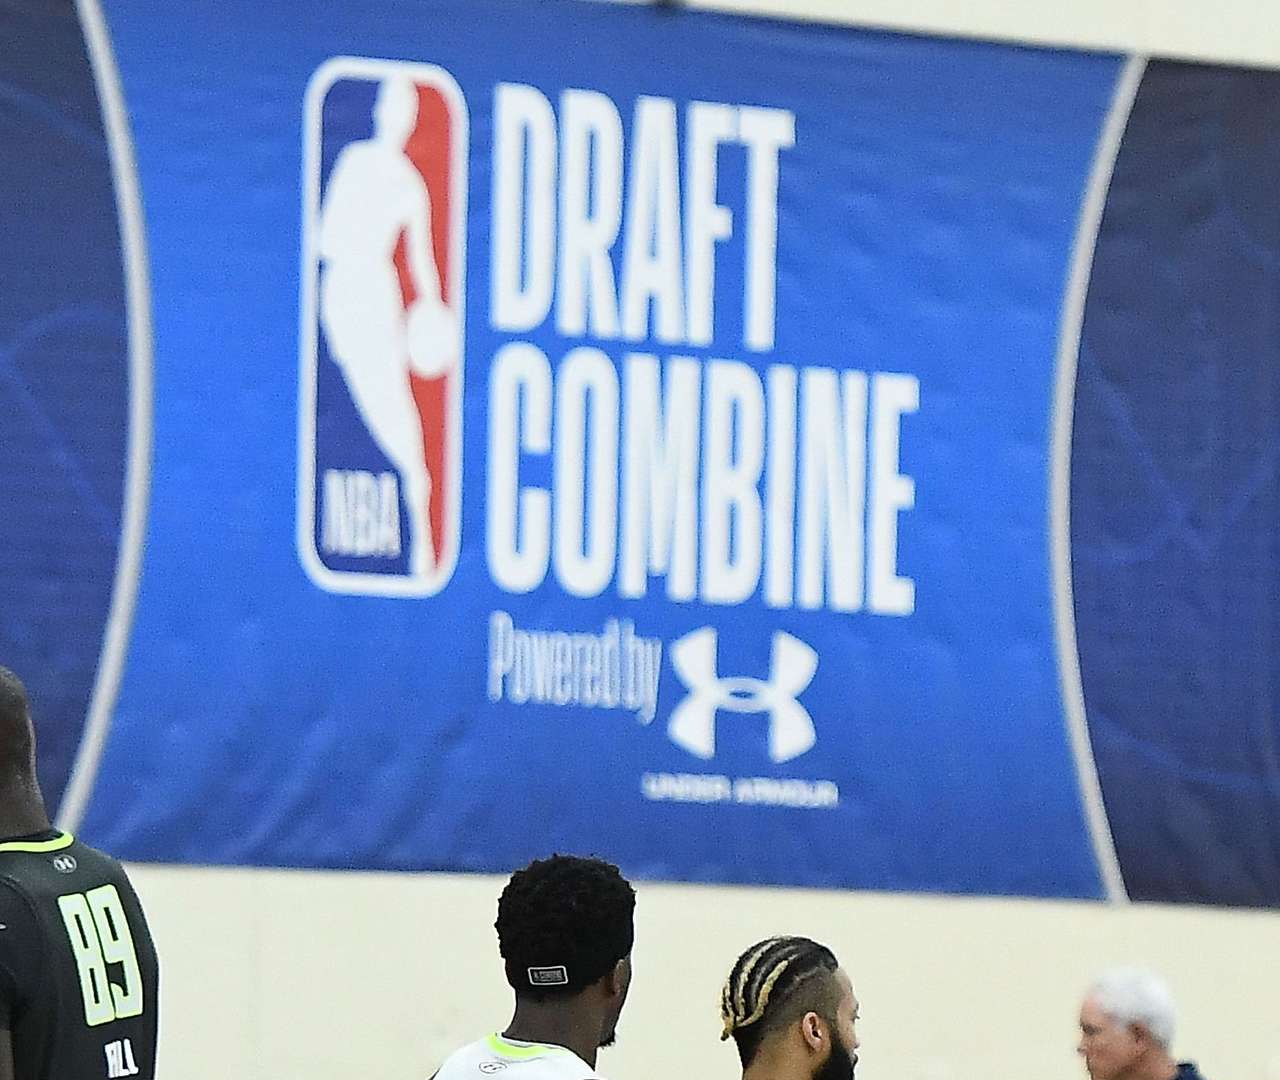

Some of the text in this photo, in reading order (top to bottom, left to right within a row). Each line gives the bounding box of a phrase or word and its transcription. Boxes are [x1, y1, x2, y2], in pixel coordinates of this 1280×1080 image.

[490, 81, 797, 353] DRAFT
[322, 468, 403, 558] NBA
[486, 340, 920, 617] COMBINE
[487, 609, 619, 711] Powered
[57, 883, 144, 1027] 89
